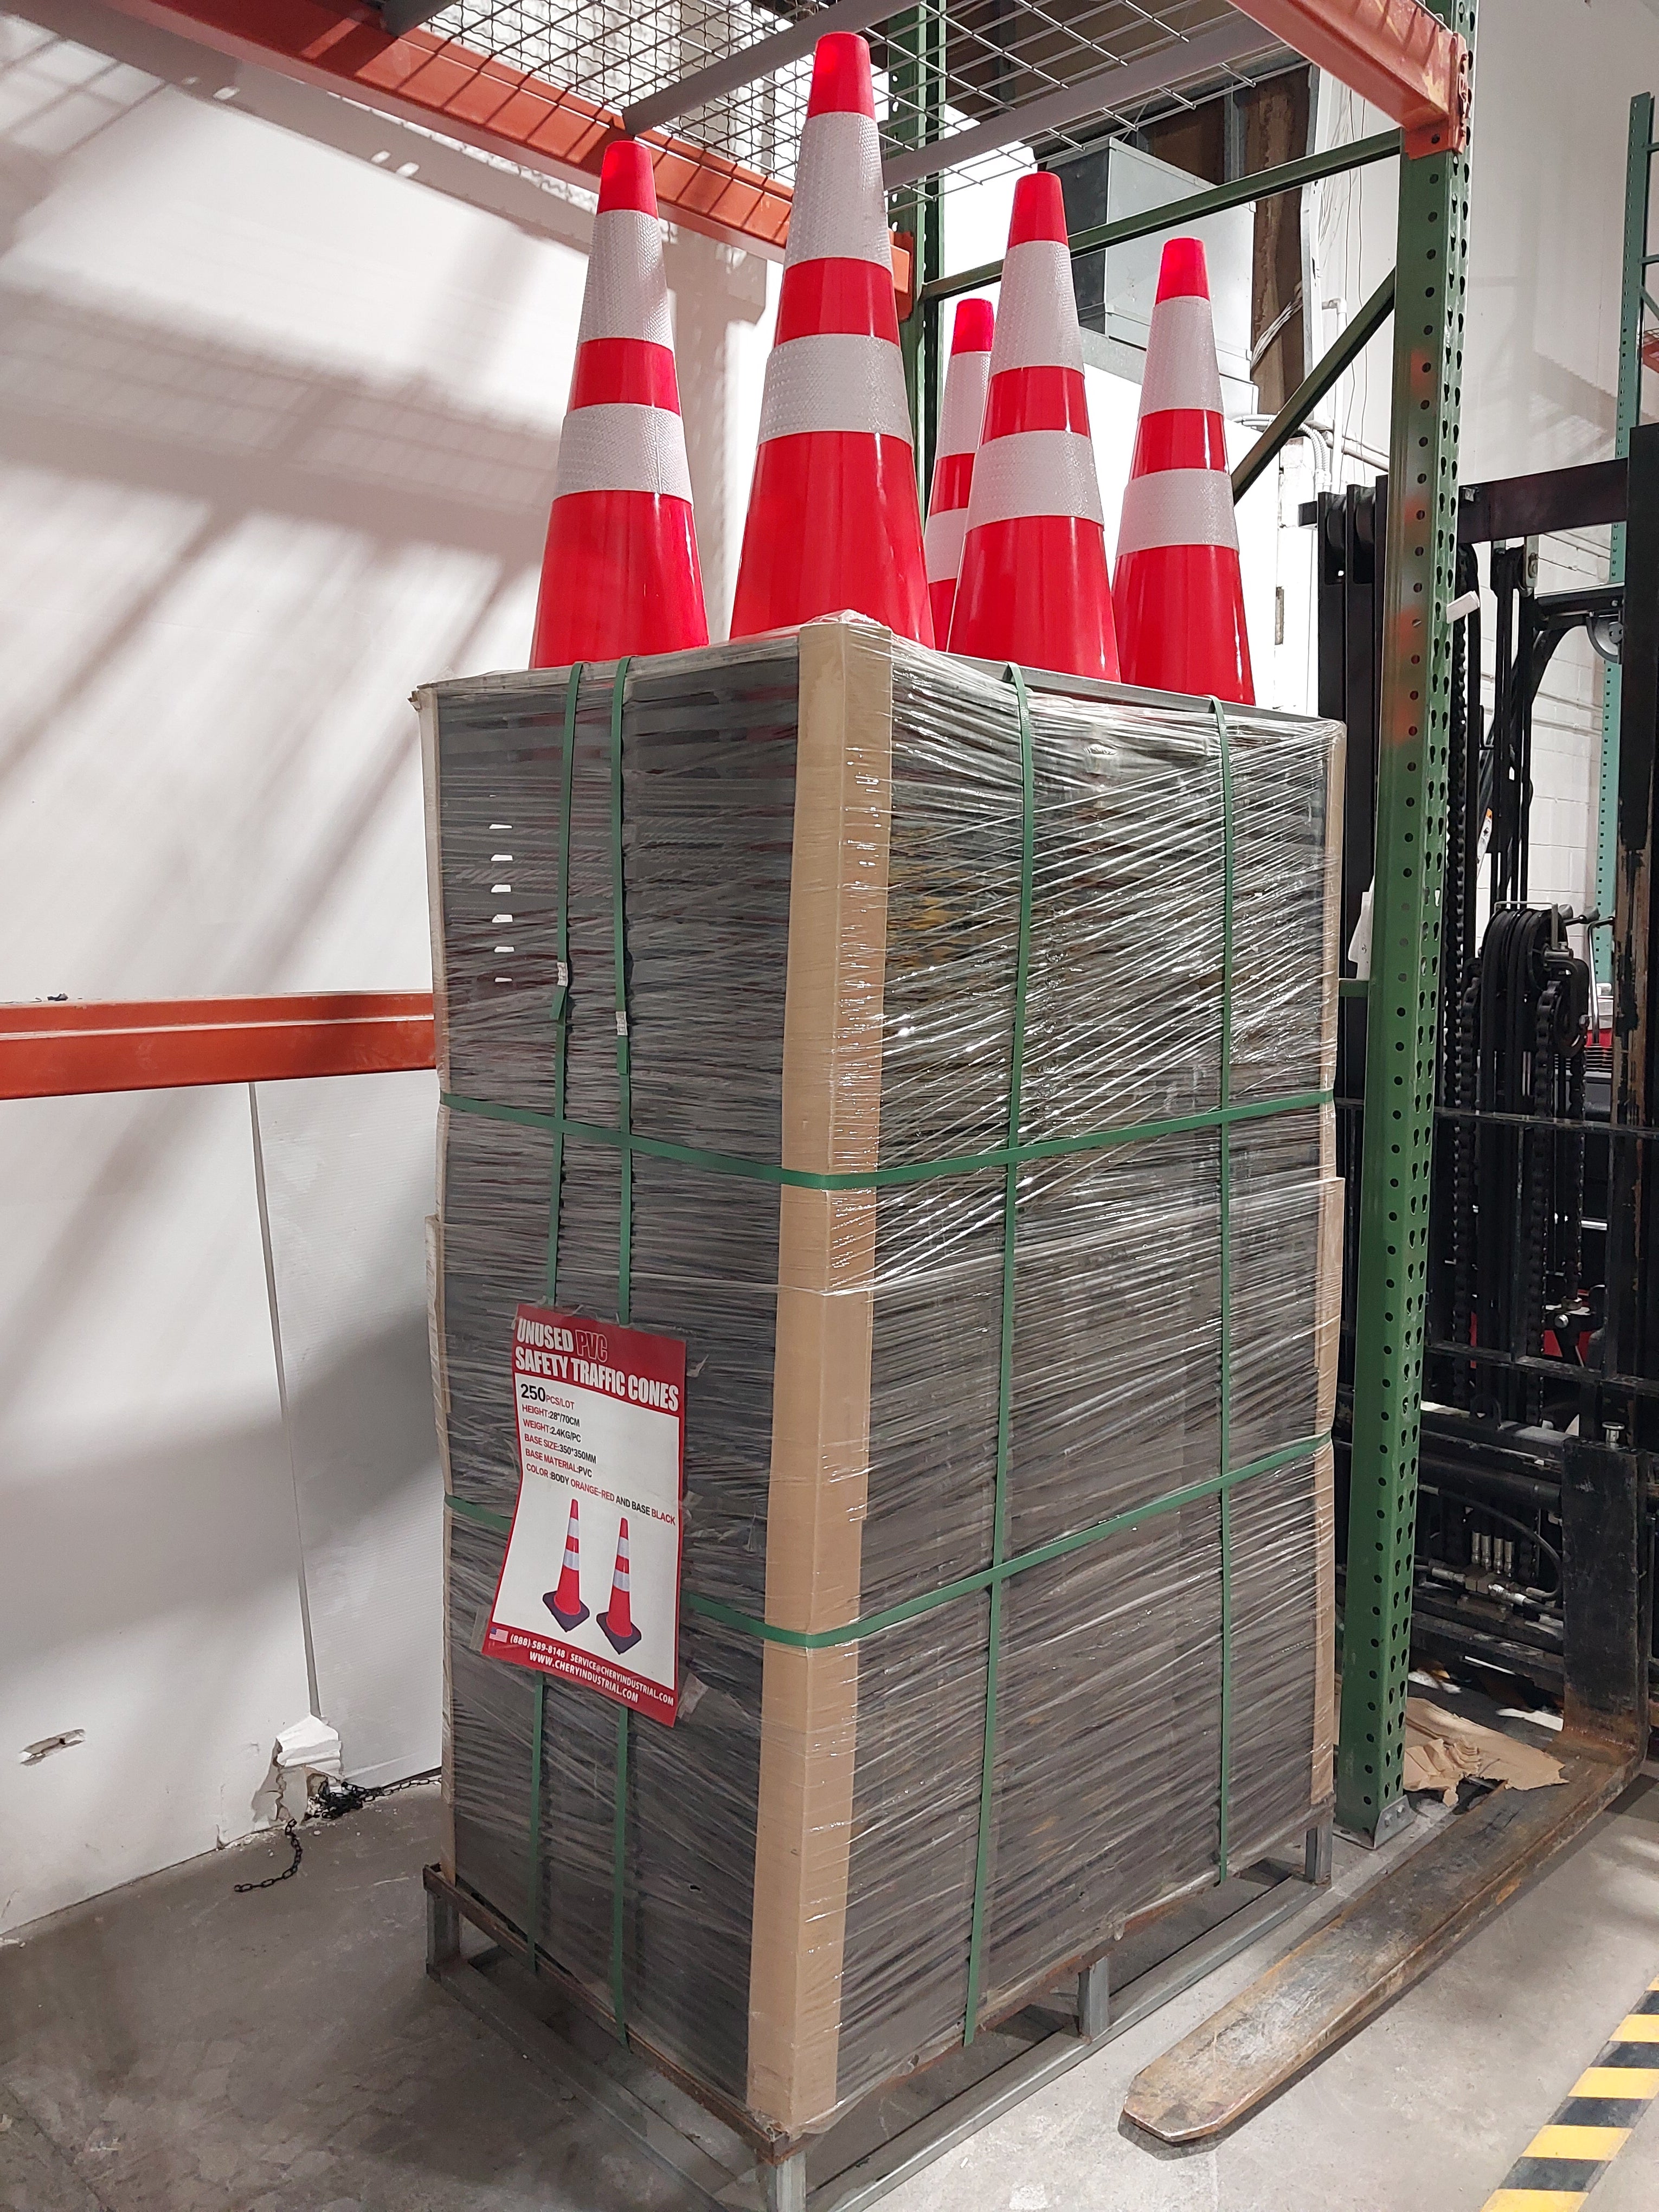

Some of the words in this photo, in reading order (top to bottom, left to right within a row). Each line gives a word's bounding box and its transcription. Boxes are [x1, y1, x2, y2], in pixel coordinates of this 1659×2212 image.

[517, 1319, 574, 1353] UNUSED
[575, 1330, 608, 1363] PVC
[515, 1346, 568, 1379] SAFETY
[570, 1359, 626, 1397] TRAFFIC
[628, 1374, 679, 1412] CONES
[524, 1433, 543, 1446] BASE
[525, 1448, 543, 1461] BASE
[526, 1463, 548, 1478] COLOR
[571, 1478, 615, 1502] ORANGE-RED
[616, 1495, 631, 1508] AND
[632, 1502, 651, 1516] BASE
[651, 1508, 676, 1526] BLACK
[510, 1634, 531, 1649] (888)
[531, 1640, 565, 1658] 589-8148
[570, 1653, 674, 1707] SERVICE@CHERYINDUSTRIAL.COM
[529, 1651, 639, 1703] WWW.CHERYINDUSTRIAL.COM
